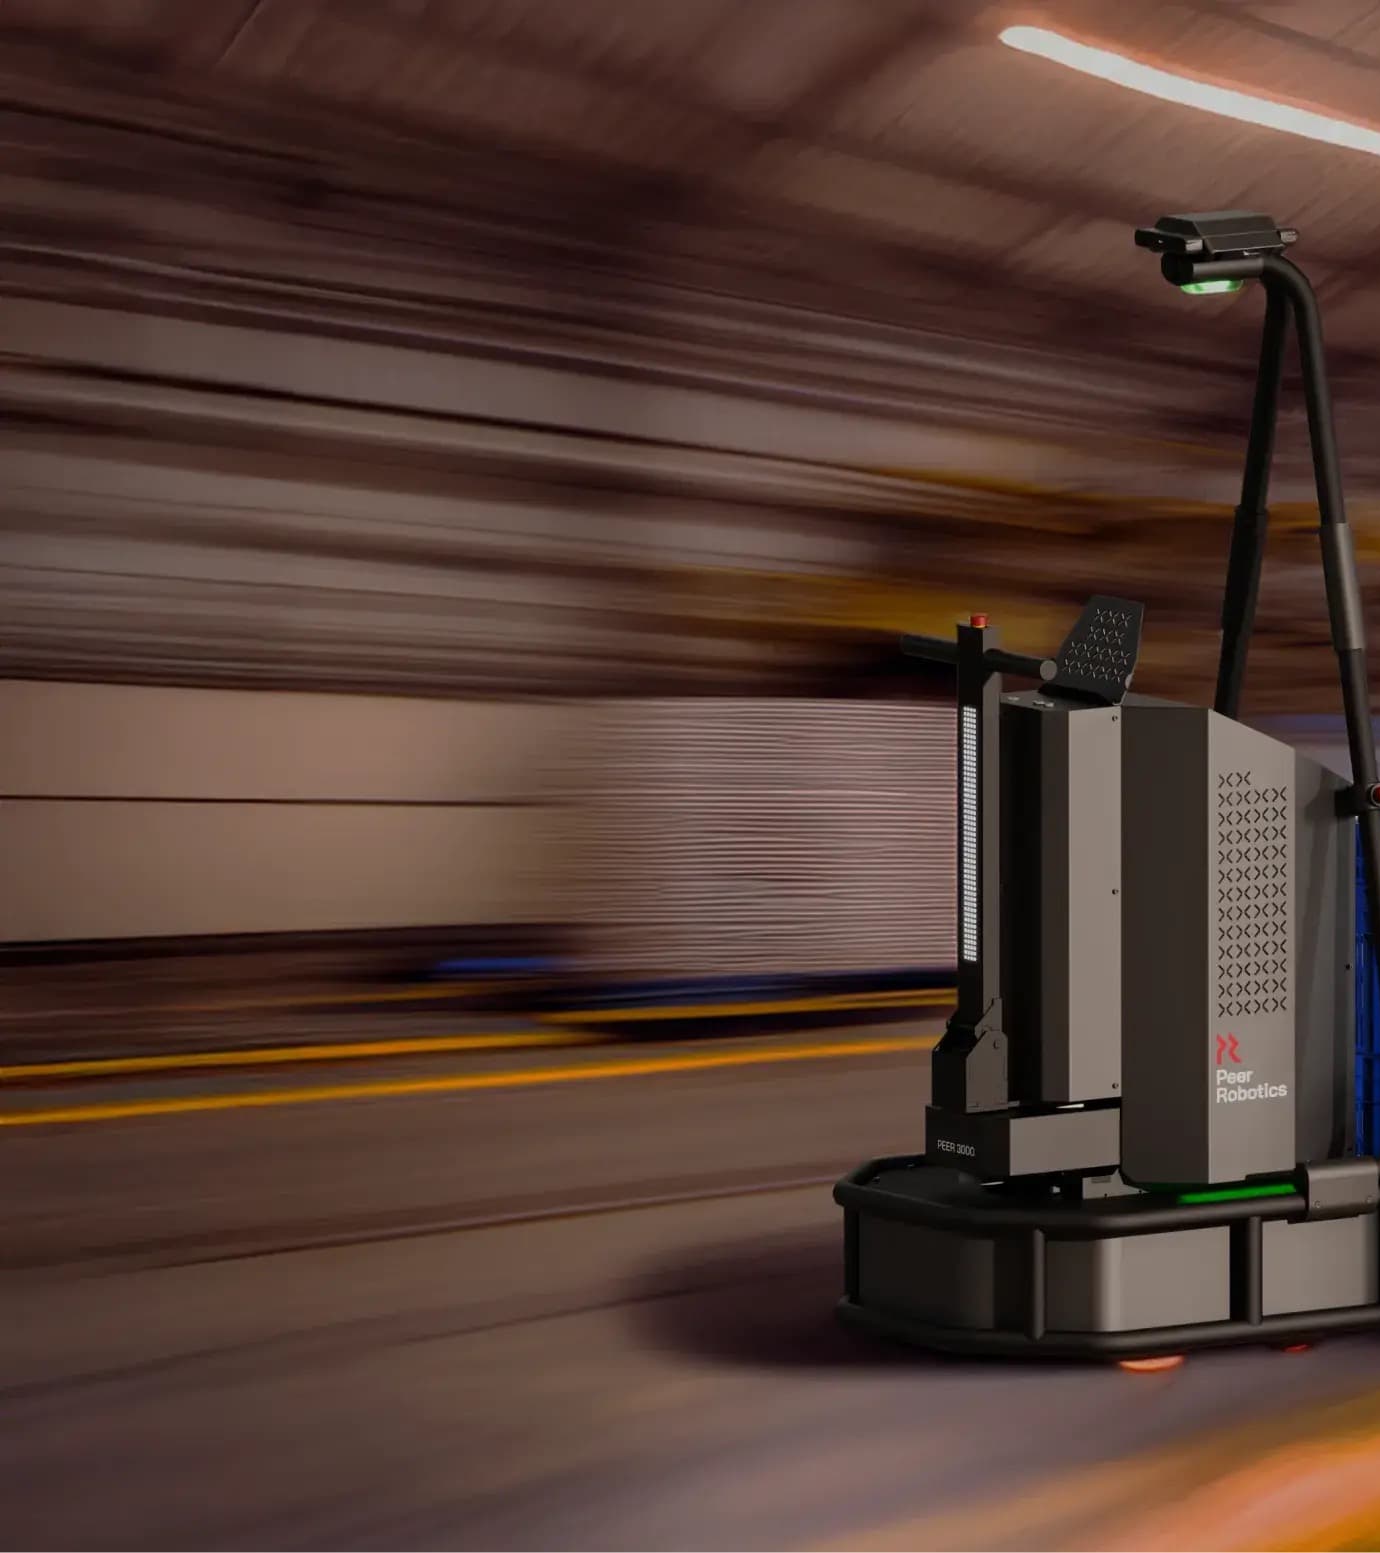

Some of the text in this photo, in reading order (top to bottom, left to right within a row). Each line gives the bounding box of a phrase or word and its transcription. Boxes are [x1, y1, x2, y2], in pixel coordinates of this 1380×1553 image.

[1216, 1069, 1254, 1086] Peer
[1216, 1083, 1288, 1103] Robotics
[937, 1139, 956, 1152] PEER
